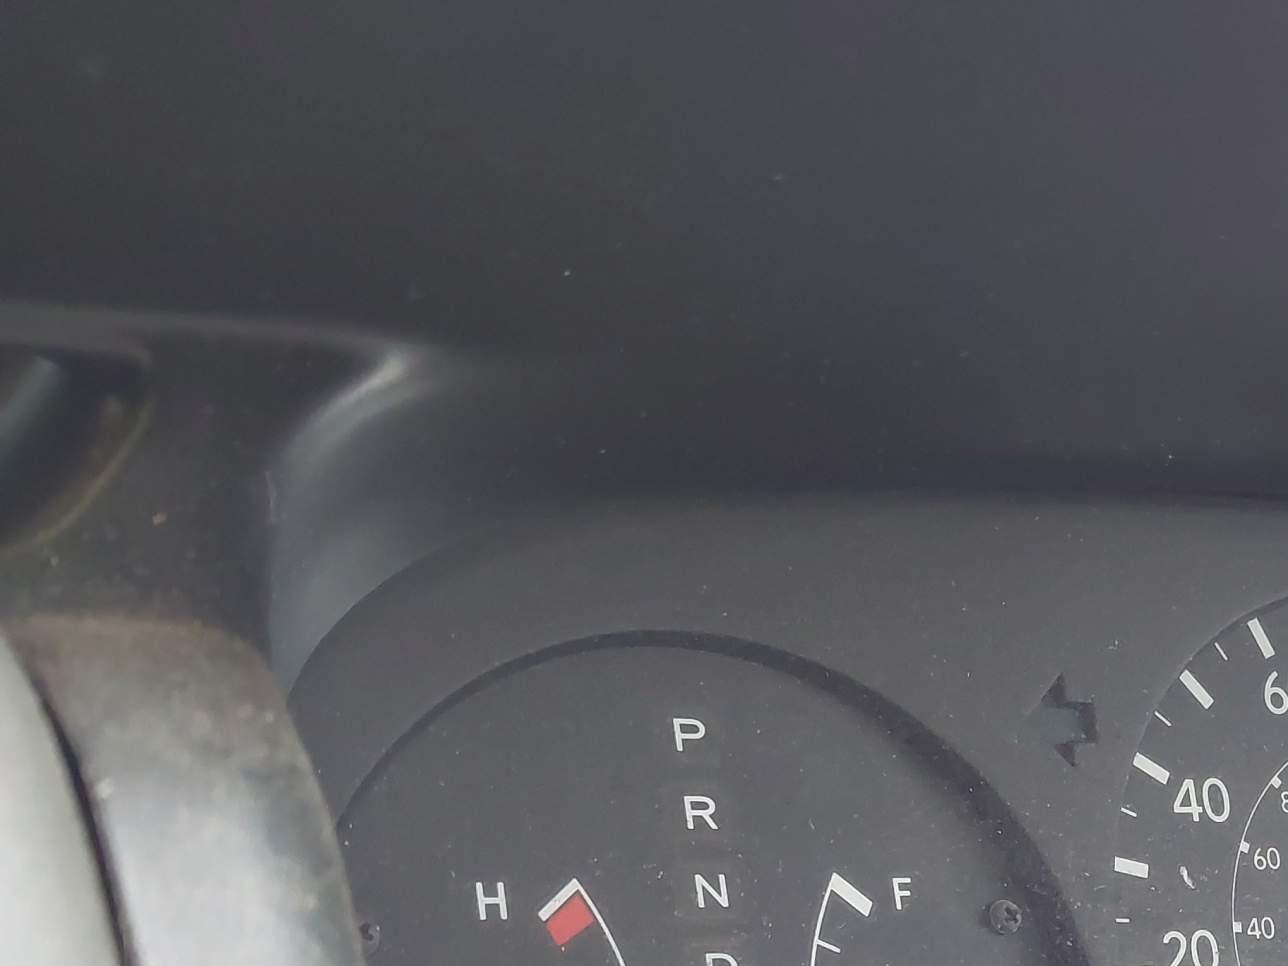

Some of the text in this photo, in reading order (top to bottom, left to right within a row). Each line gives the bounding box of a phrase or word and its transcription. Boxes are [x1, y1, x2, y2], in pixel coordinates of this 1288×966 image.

[672, 718, 706, 751] P
[683, 796, 718, 830] R
[1173, 777, 1231, 823] 40
[1253, 848, 1281, 870] 60
[475, 882, 508, 920] H
[694, 874, 729, 907] N
[891, 877, 912, 910] F
[1247, 917, 1275, 940] 40
